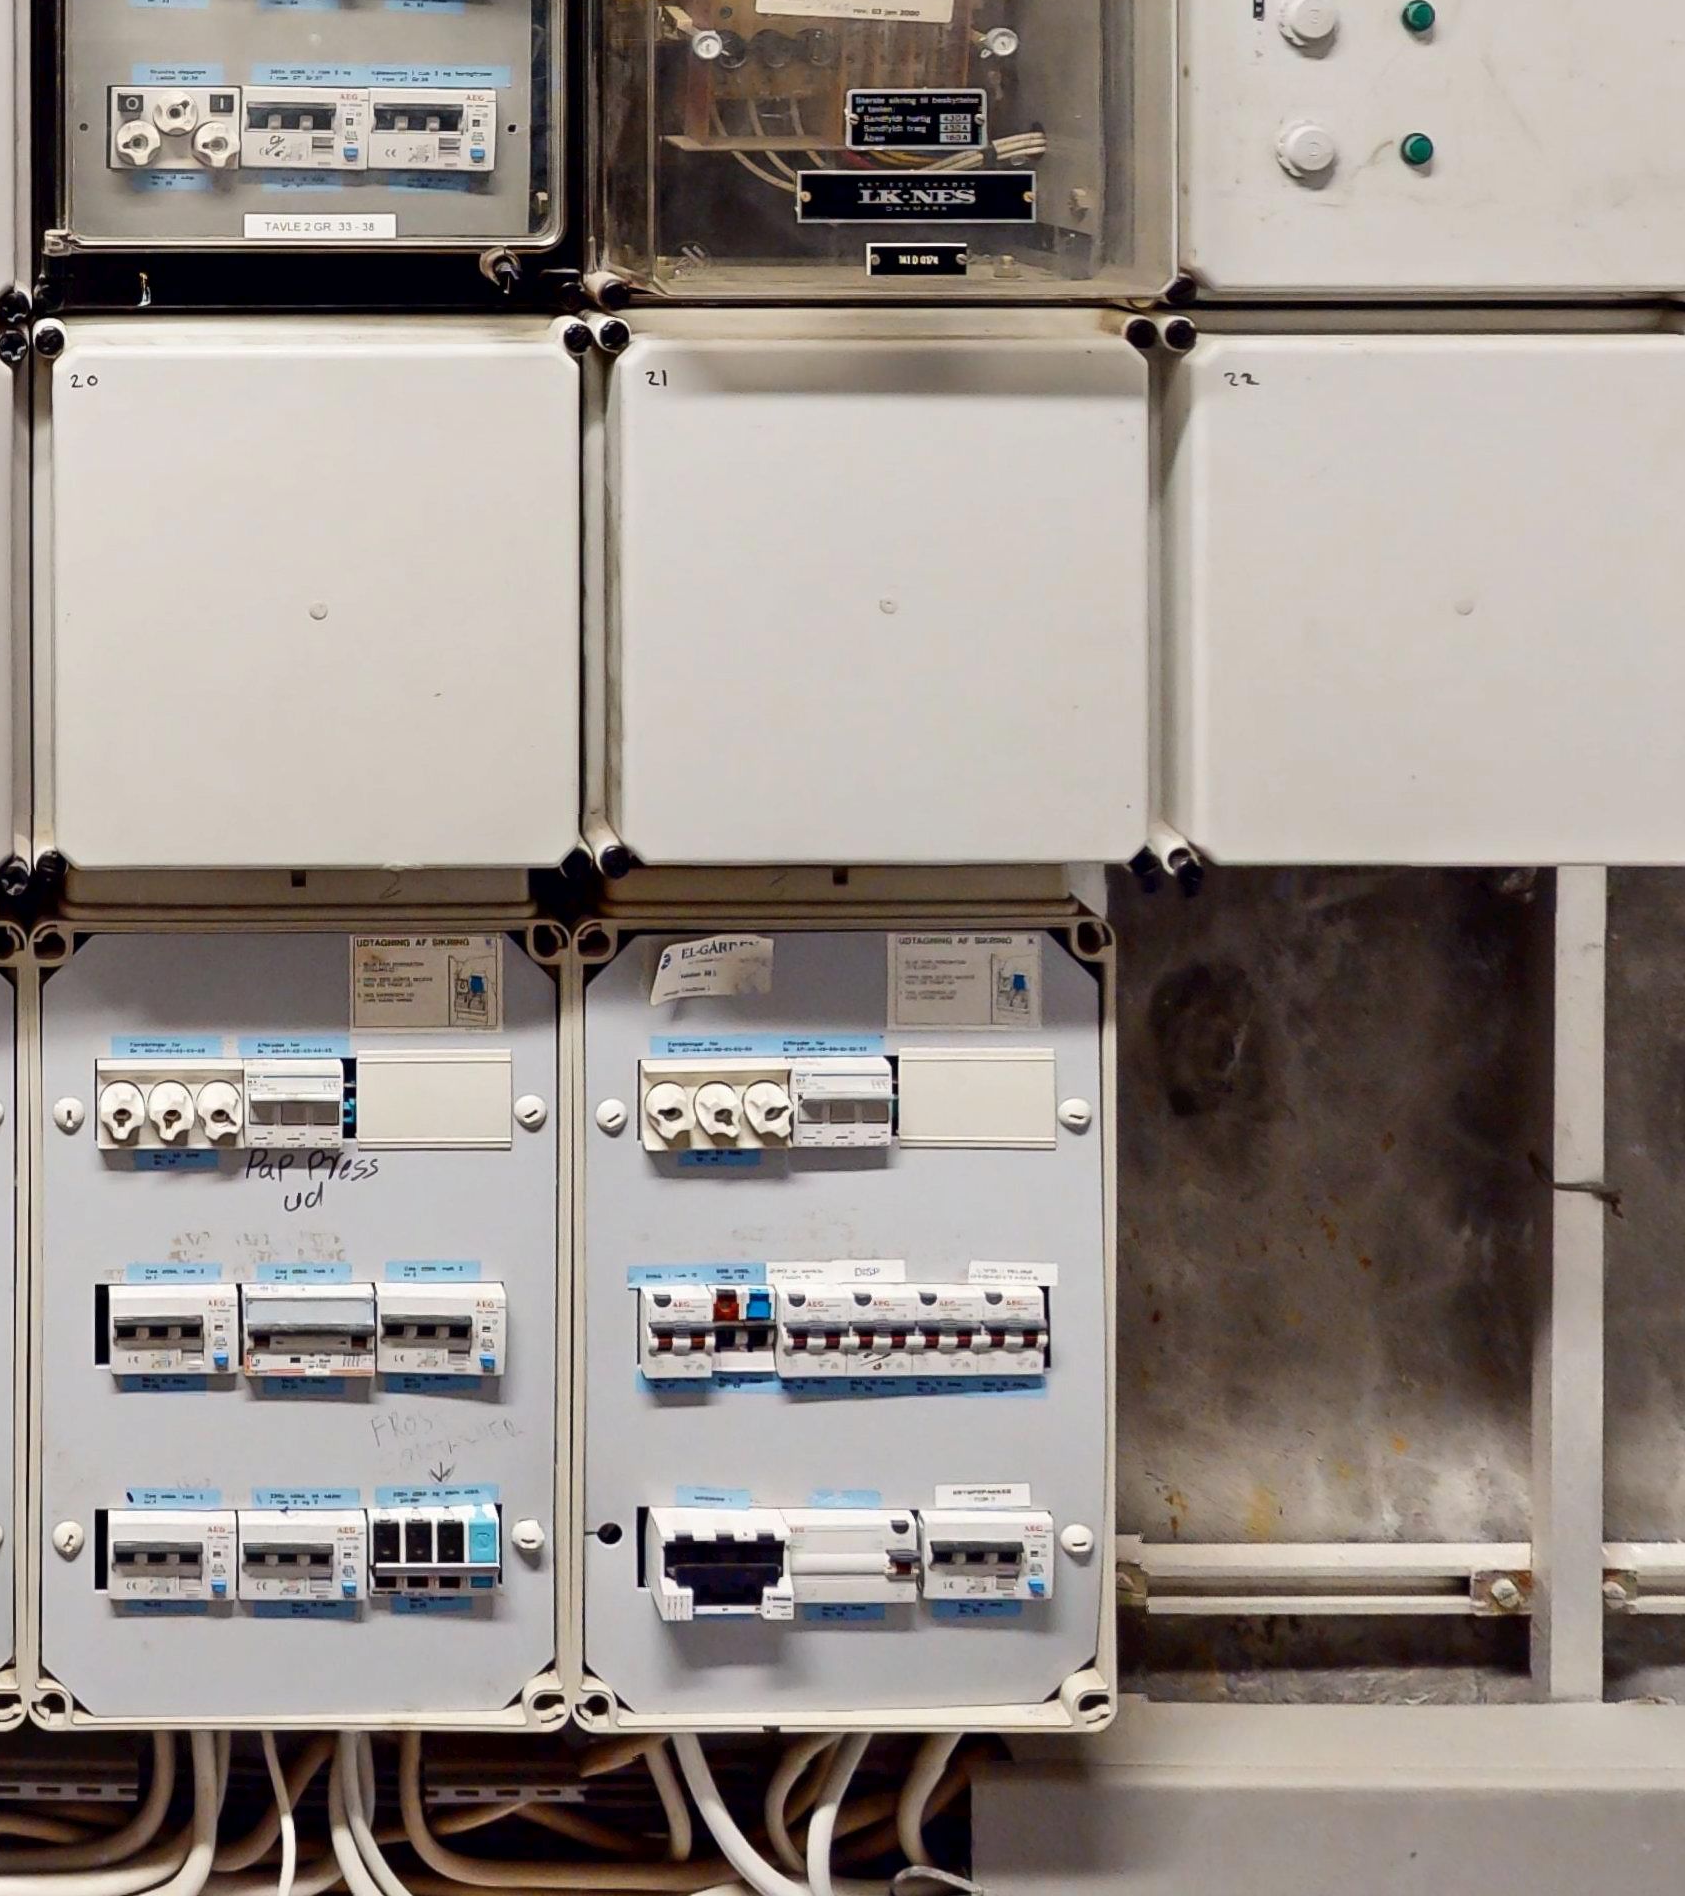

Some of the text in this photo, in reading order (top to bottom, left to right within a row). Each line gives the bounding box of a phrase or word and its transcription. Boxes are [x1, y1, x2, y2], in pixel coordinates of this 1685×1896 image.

[857, 189, 976, 204] LK-NES
[265, 221, 301, 233] TAVLE
[303, 221, 312, 232] 2
[338, 221, 353, 232] 33
[362, 221, 375, 232] 38
[69, 374, 98, 390] 20
[645, 370, 668, 387] 21
[1223, 372, 1261, 387] 22
[415, 938, 428, 947] AF
[244, 1150, 289, 1183] Pap
[283, 1181, 324, 1212] ud
